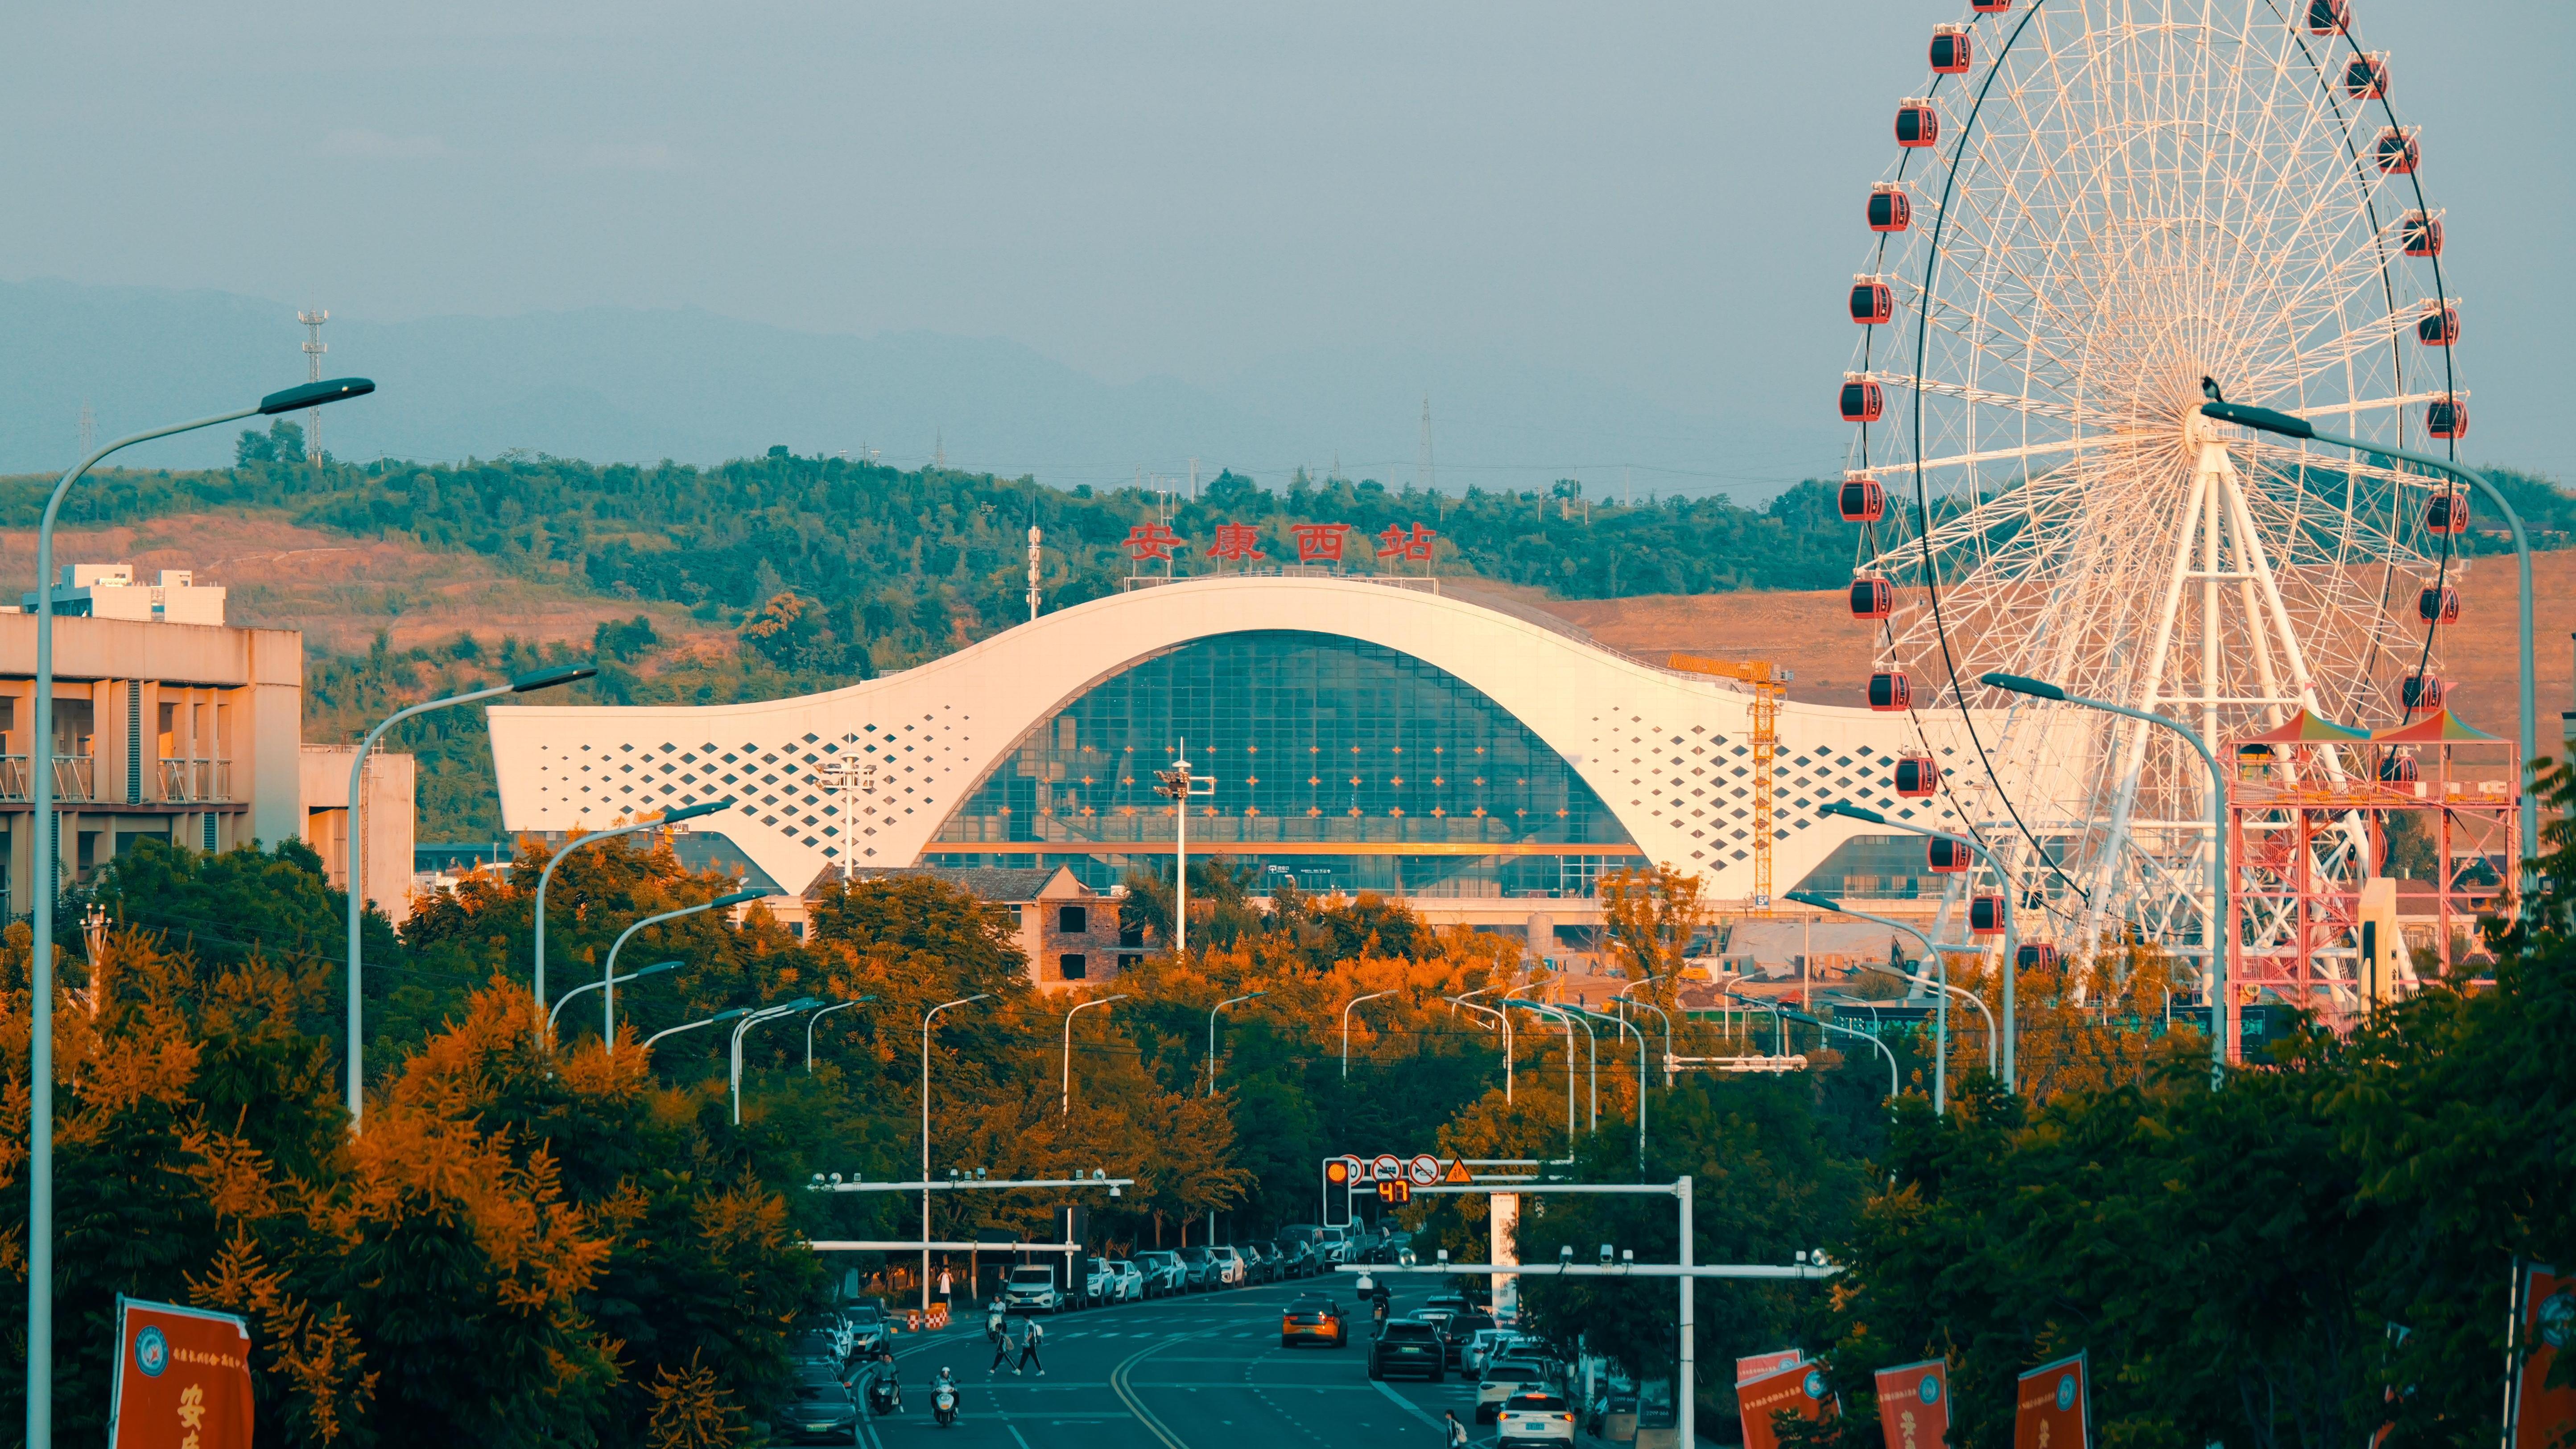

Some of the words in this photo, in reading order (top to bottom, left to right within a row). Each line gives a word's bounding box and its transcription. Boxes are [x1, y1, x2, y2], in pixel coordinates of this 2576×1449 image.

[1122, 522, 1436, 561] 安康西站
[1350, 1164, 1358, 1178] 0
[1379, 1180, 1408, 1202] 47
